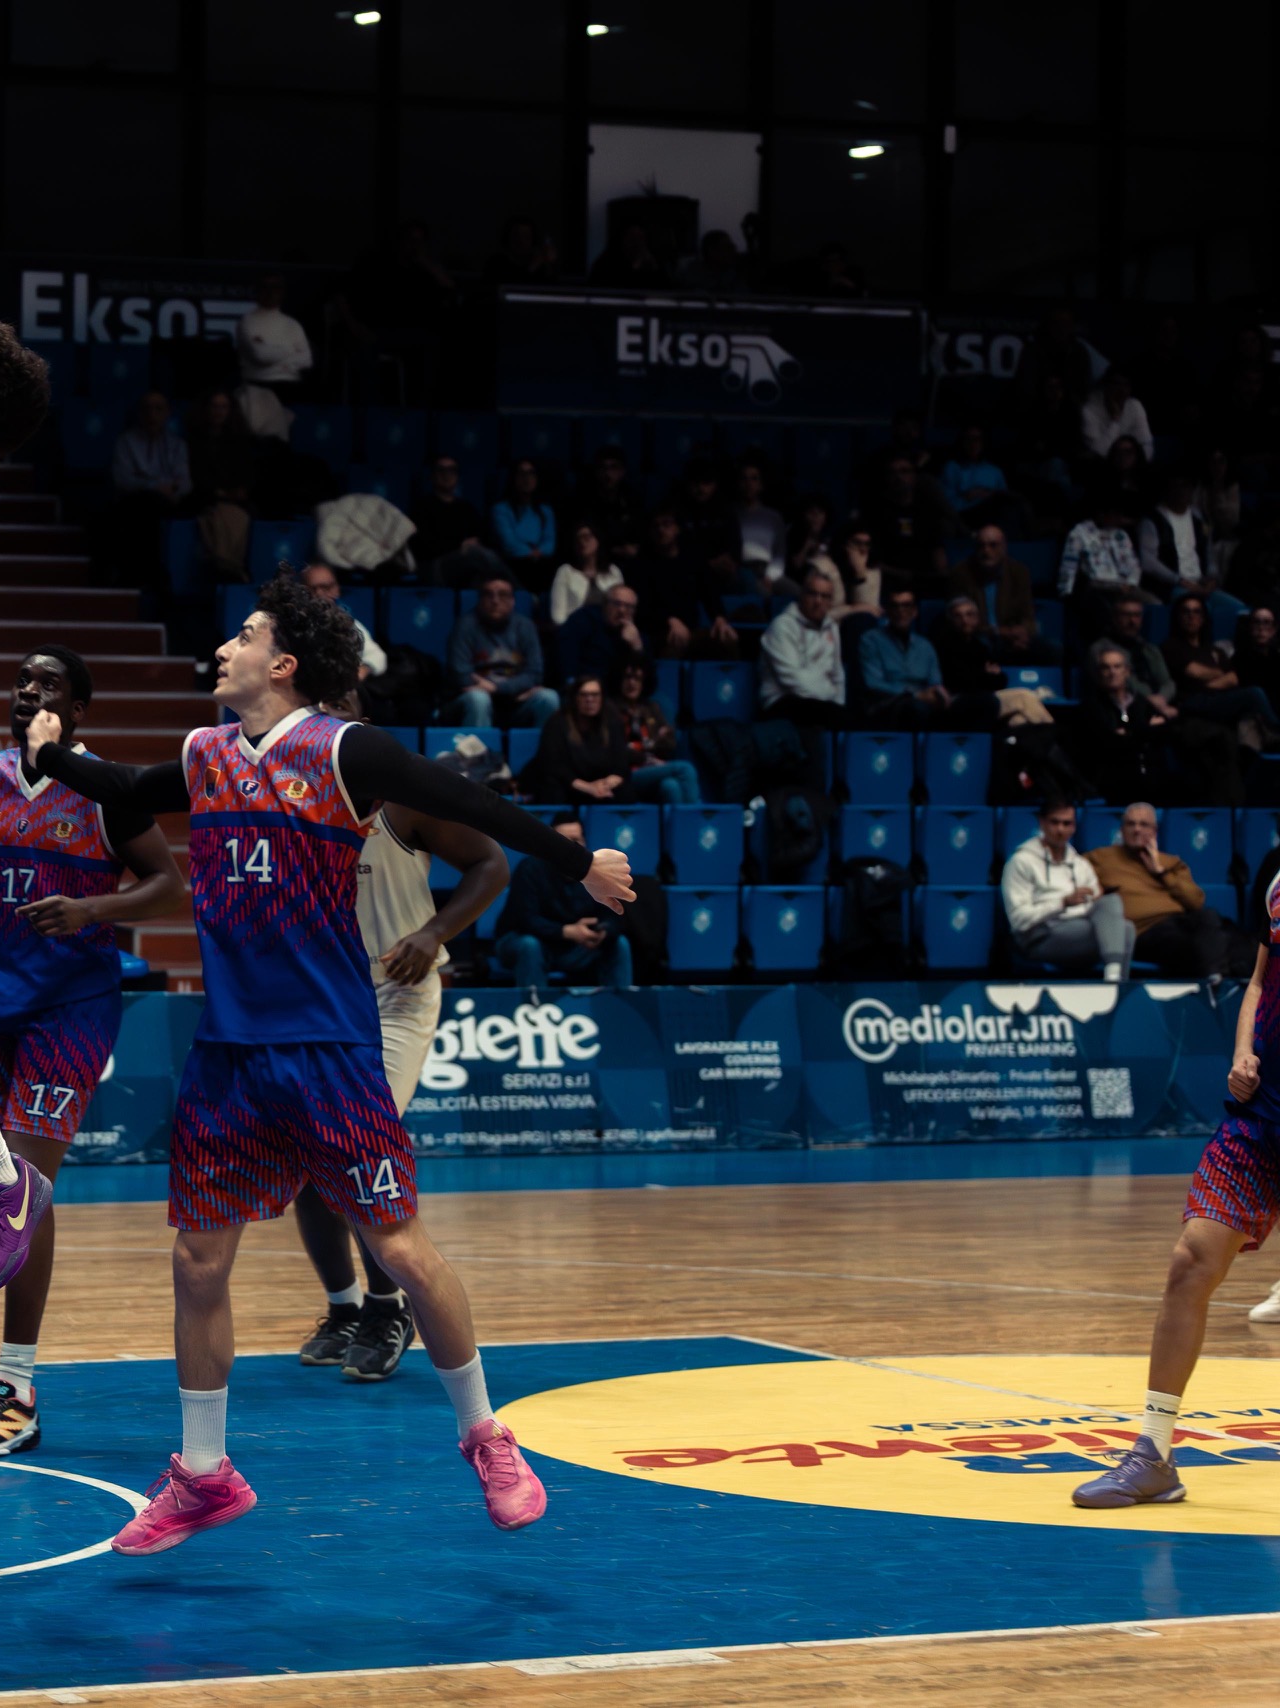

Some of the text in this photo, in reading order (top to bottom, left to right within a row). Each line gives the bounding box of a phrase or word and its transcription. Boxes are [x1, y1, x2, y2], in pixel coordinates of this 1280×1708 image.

[617, 315, 729, 368] Ekso
[224, 837, 274, 884] 14
[0, 866, 36, 903] 17
[420, 997, 601, 1091] gieffe
[964, 1042, 1077, 1058] PRIVATE BANKING
[25, 1081, 77, 1121] 17
[501, 1074, 561, 1091] SERVIZI
[480, 1095, 548, 1111] ESTERNA
[549, 1094, 596, 1109] VISIVA
[347, 1157, 403, 1206] 14
[869, 1411, 1219, 1433] POMESSA
